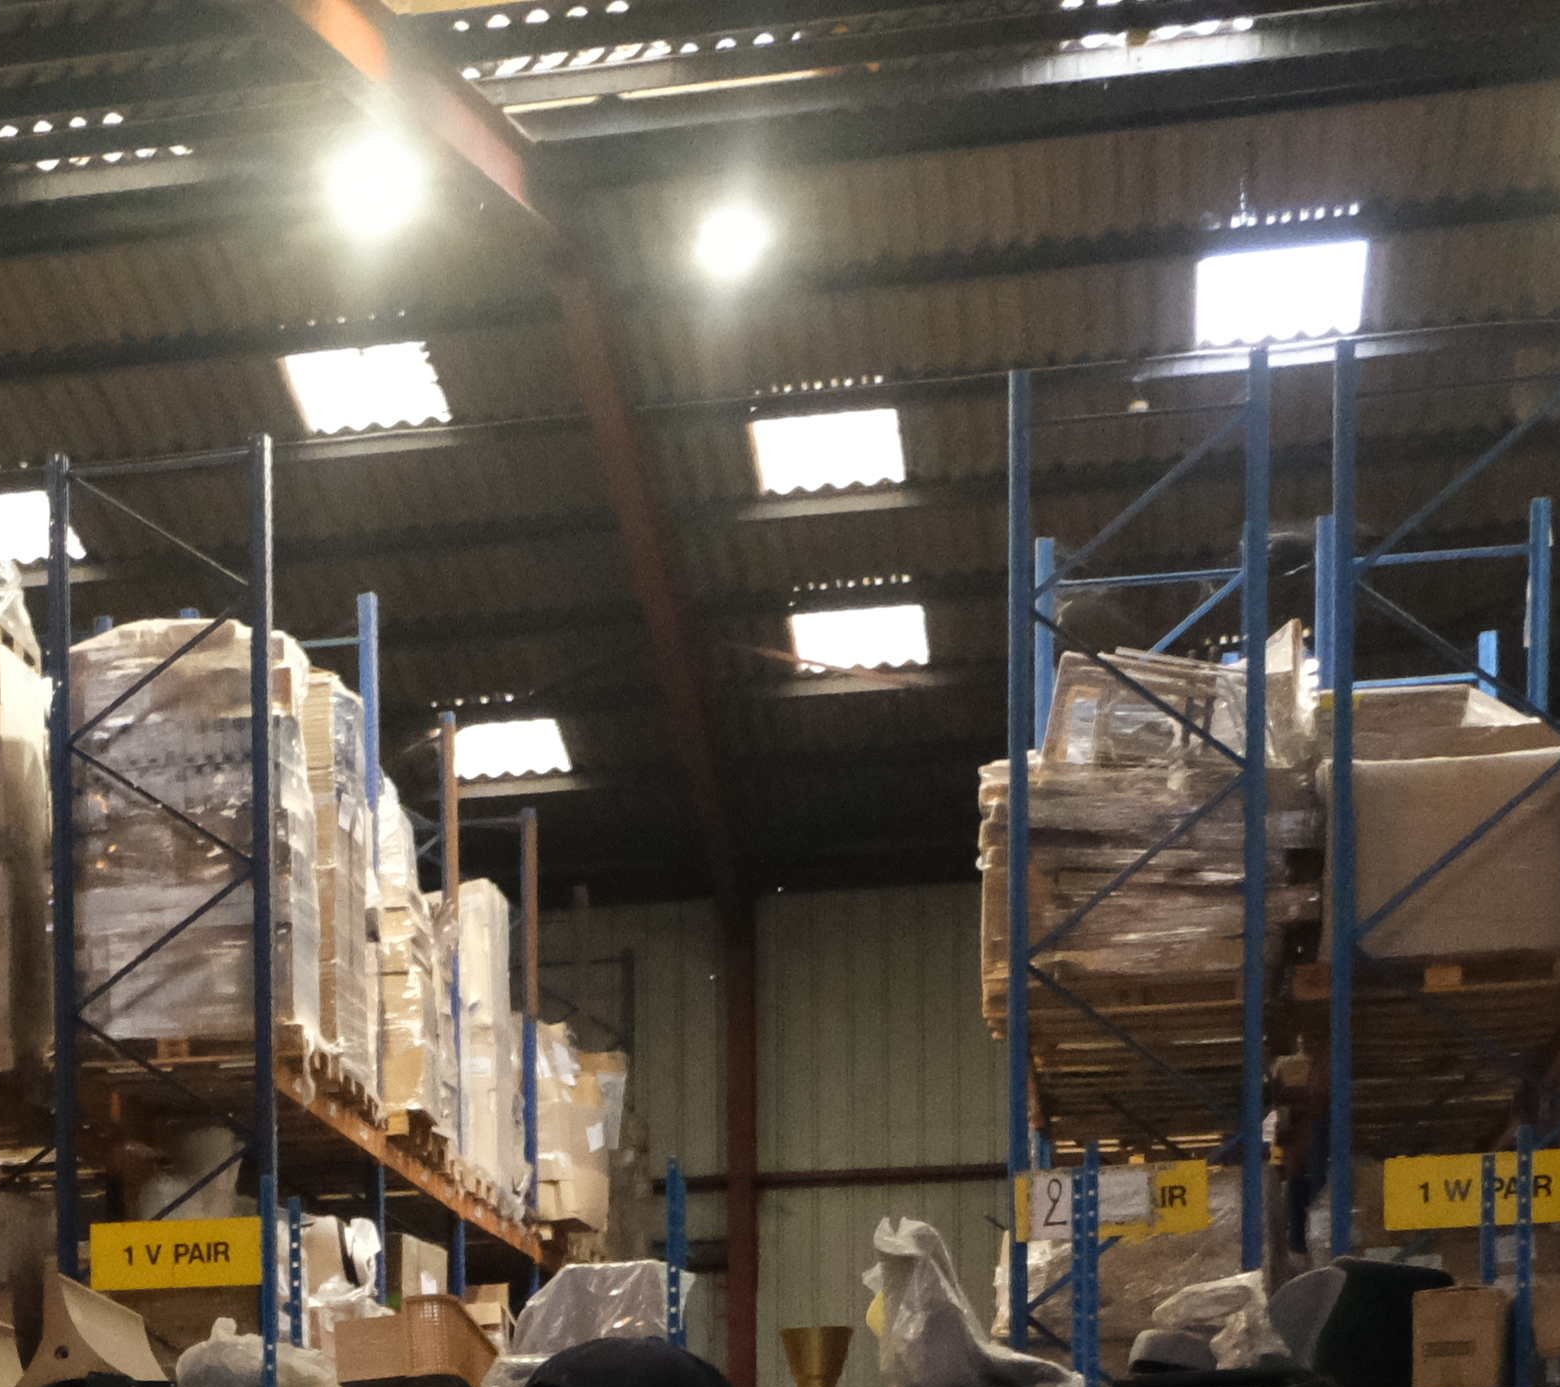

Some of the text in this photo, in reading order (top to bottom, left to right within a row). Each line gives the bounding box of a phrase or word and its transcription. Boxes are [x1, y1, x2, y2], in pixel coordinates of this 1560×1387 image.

[1160, 1184, 1187, 1208] IR
[1418, 1174, 1553, 1203] 1 W PAR
[1043, 1178, 1068, 1227] 2
[123, 1241, 230, 1266] 1 V PAIR
